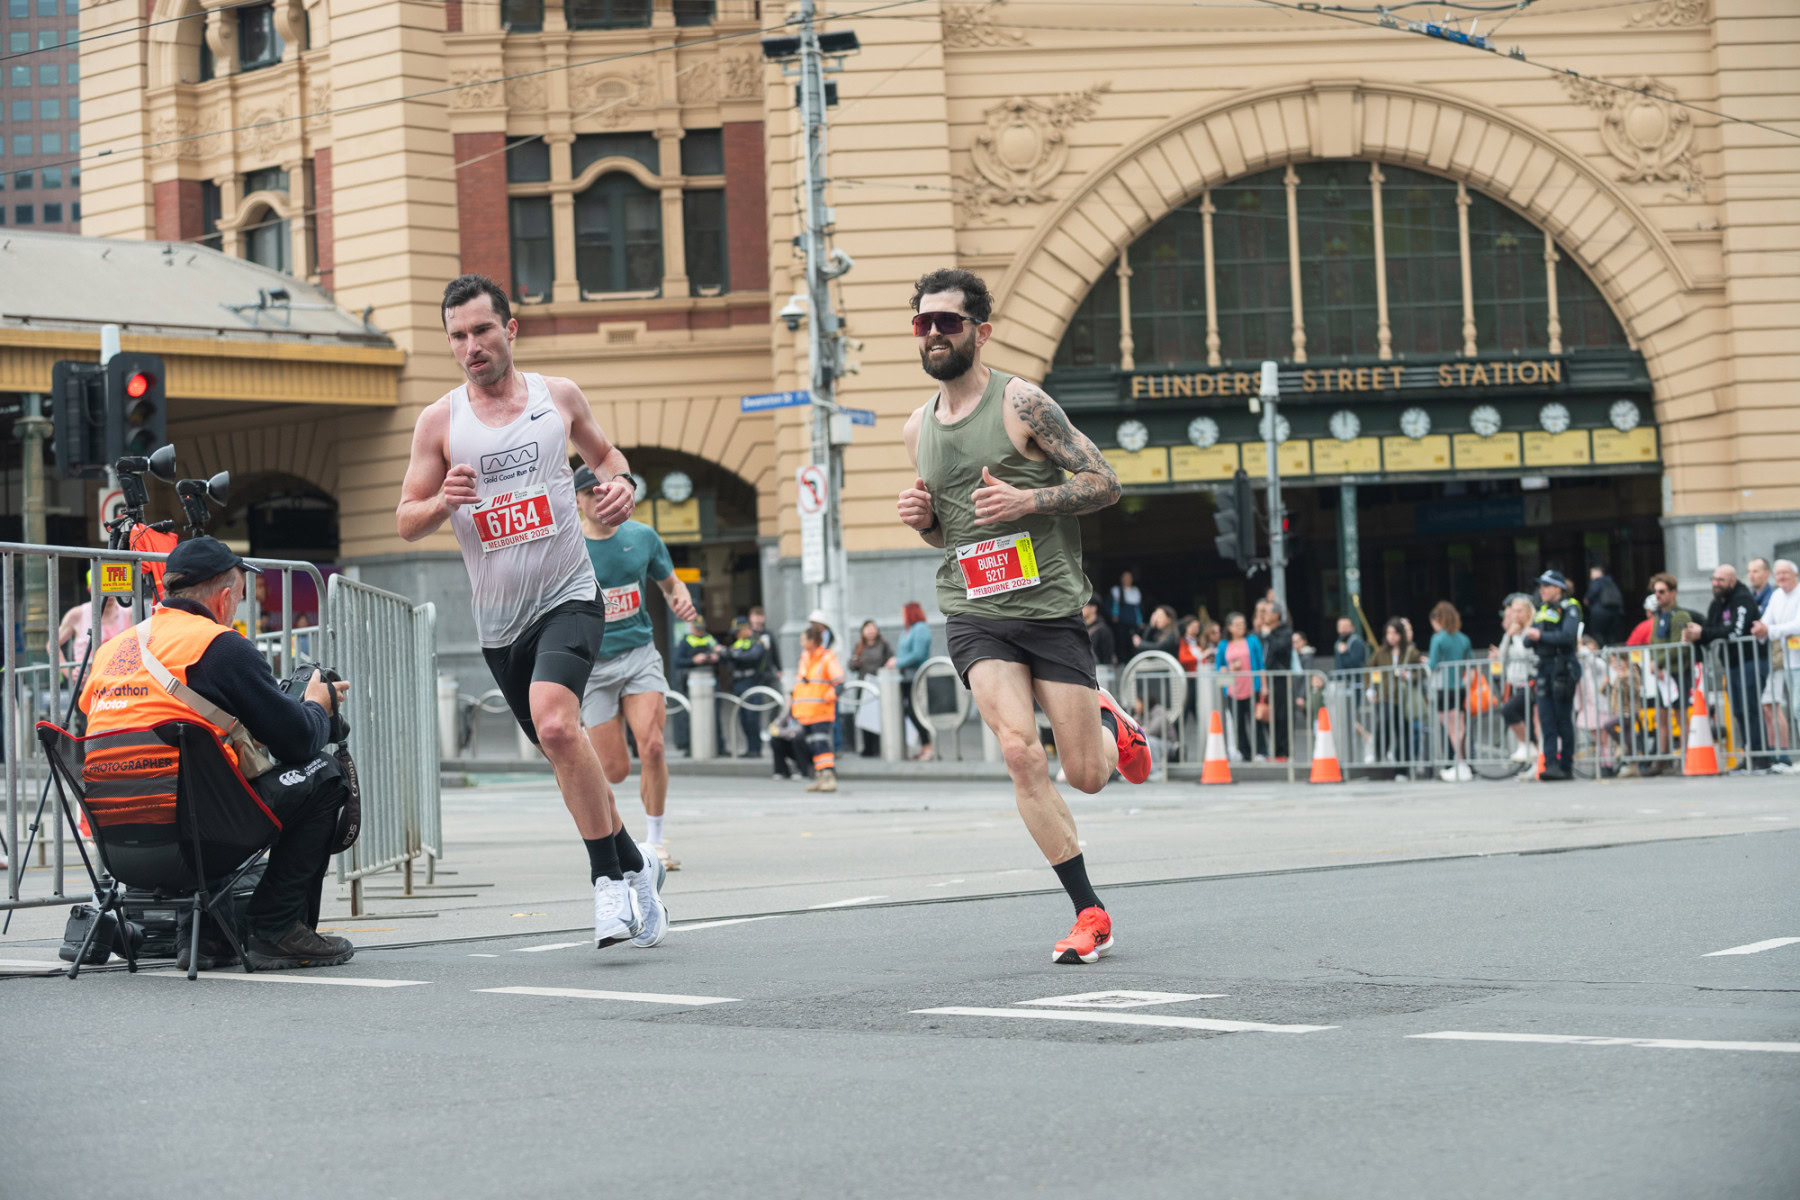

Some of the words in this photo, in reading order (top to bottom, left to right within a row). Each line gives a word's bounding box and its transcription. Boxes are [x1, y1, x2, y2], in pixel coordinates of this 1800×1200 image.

[1131, 373, 1262, 398] FLINDERS
[1303, 366, 1404, 392] STREET
[1439, 360, 1561, 387] STATION
[484, 475, 498, 484] Gold
[499, 472, 516, 482] Coast
[528, 465, 538, 473] Co.
[486, 500, 541, 538] 6754
[488, 532, 529, 549] MELBOURNE
[530, 527, 550, 539] 2025
[978, 552, 1009, 571] BURLEY
[106, 566, 125, 582] TFH
[986, 567, 1006, 583] 5217
[973, 581, 1011, 597] MELBOURNE
[1011, 578, 1033, 589] 2025
[89, 757, 173, 773] PHOTOGRAPHER
[347, 761, 359, 797] Canon
[342, 823, 358, 846] EOS
